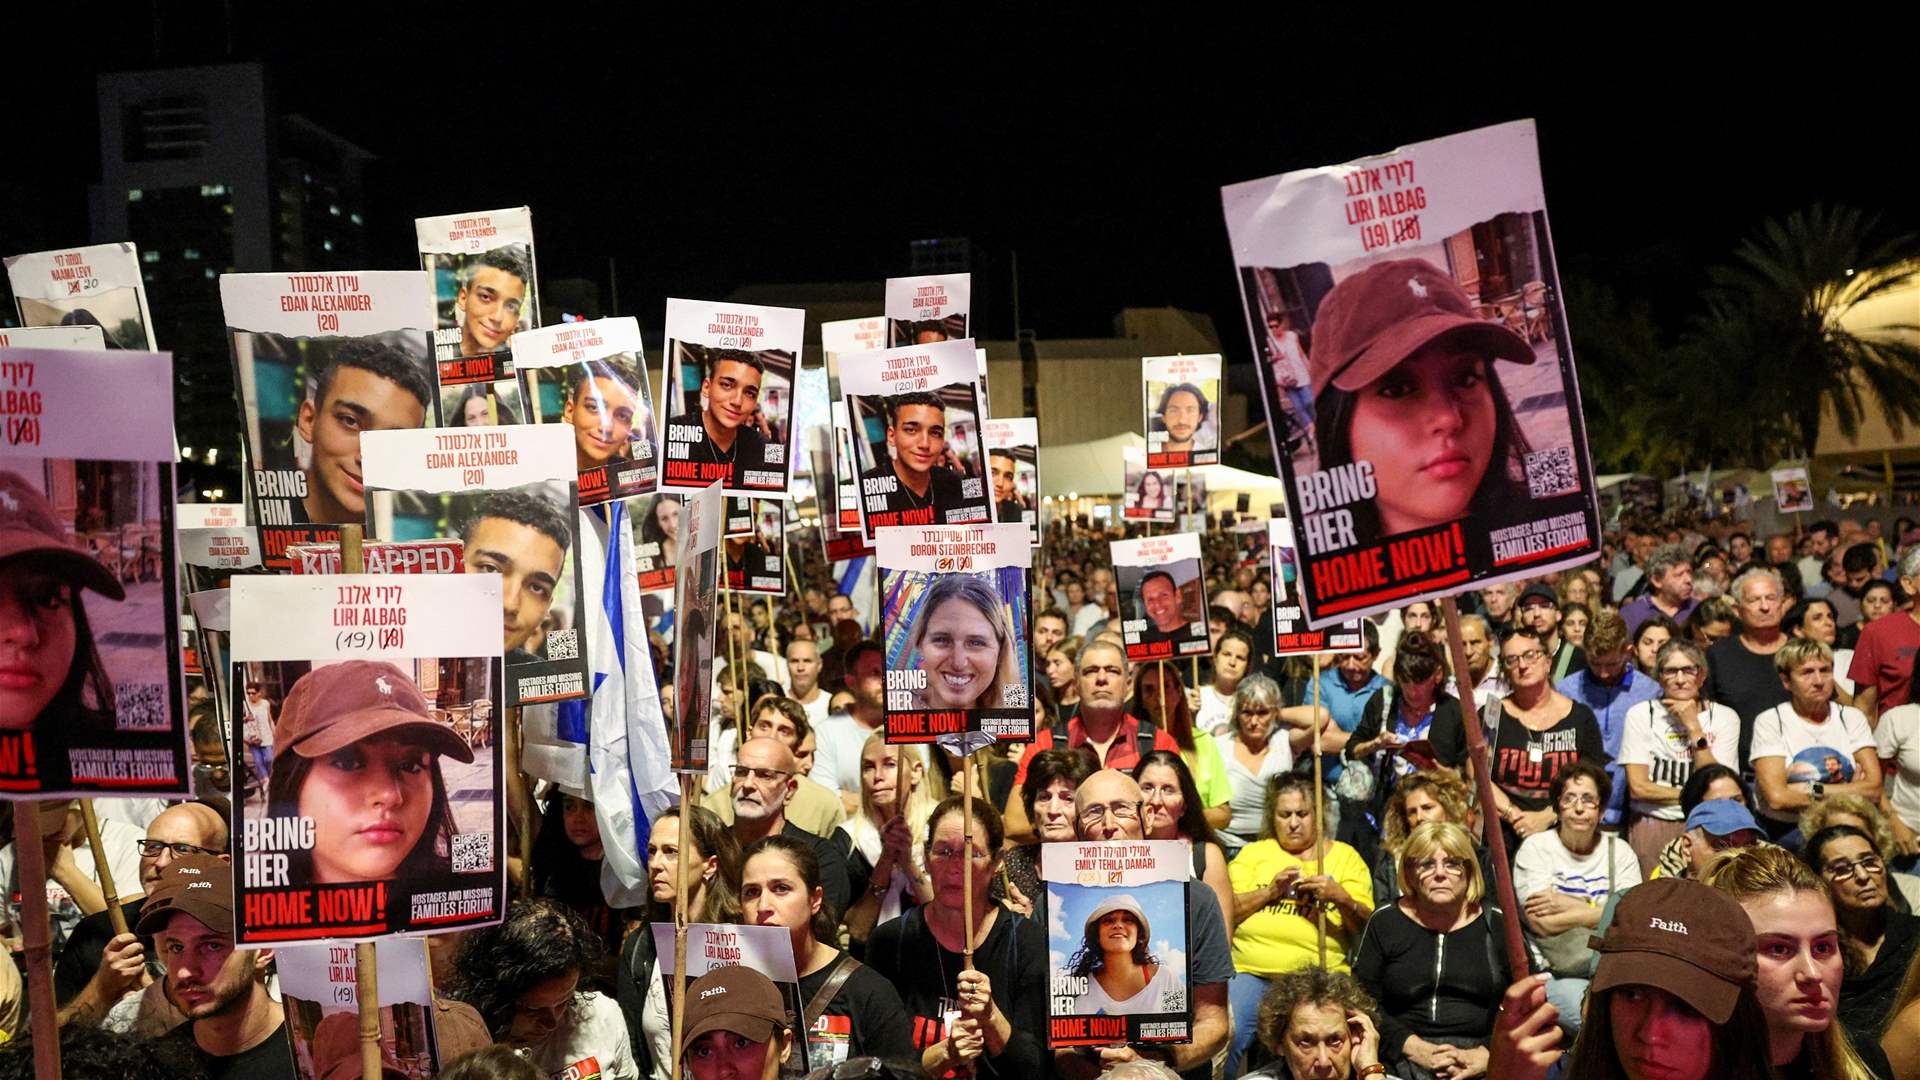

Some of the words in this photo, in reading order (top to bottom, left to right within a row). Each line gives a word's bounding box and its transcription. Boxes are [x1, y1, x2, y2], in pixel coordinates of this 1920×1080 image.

[1343, 167, 1383, 197] אלבג
[1384, 159, 1415, 187] לירי
[1344, 199, 1375, 226] LIRI
[1378, 186, 1427, 218] ALBAG
[449, 230, 464, 241] EDAN
[465, 226, 497, 239] ALEXANDER
[1360, 221, 1390, 252] (19)
[1392, 215, 1421, 243] (18)
[84, 278, 98, 290] 20
[288, 276, 334, 293] אלכסנדר
[337, 276, 359, 293] עידן
[280, 296, 309, 312] EDAN
[311, 294, 372, 312] ALEXANDER
[317, 314, 339, 332] (20)
[708, 323, 725, 335] EDAN
[727, 325, 764, 338] ALEXANDER
[434, 328, 463, 345] BRING
[552, 342, 568, 353] EDAN
[568, 337, 604, 351] ALEXANDER
[719, 336, 738, 347] (20)
[436, 344, 455, 361] HIM
[440, 361, 465, 378] HOME
[465, 356, 494, 376] NOW!
[881, 369, 899, 382] EDAN
[900, 365, 938, 379] ALEXANDER
[894, 379, 914, 392] (20)
[434, 434, 481, 450] אלכסנדר
[485, 433, 507, 450] עידן
[668, 424, 703, 443] BRING
[426, 454, 455, 470] EDAN
[457, 450, 519, 468] ALEXANDER
[667, 442, 690, 460] HIM
[463, 469, 485, 486] (20)
[577, 467, 608, 491] NOW!
[667, 461, 699, 479] HOME
[700, 462, 734, 481] NOW!
[254, 469, 308, 498] BRING
[863, 475, 898, 496] BRING
[1294, 459, 1377, 516] BRING
[258, 499, 293, 526] HIM
[865, 494, 888, 513] HIM
[868, 511, 899, 531] HOME
[901, 505, 935, 526] NOW!
[1302, 508, 1358, 556] HER
[1489, 523, 1533, 543] HOSTAGES
[1532, 518, 1550, 535] AND
[1549, 511, 1586, 531] MISSING
[910, 544, 937, 557] DORON
[938, 542, 996, 556] STEINBRECHER
[1390, 522, 1467, 580] NOW!
[1492, 535, 1547, 562] FAMILIES
[1547, 525, 1589, 549] FORUM
[302, 547, 456, 574] KIDAPPED
[1311, 547, 1389, 600] HOME
[337, 585, 371, 605] אלבג
[376, 585, 403, 605] לירי
[333, 607, 358, 627] LIRI
[362, 607, 407, 627] ALBAG
[336, 631, 375, 651] (19)
[378, 628, 404, 649] (18)
[1278, 633, 1300, 647] HOME
[886, 668, 927, 691] BRING
[519, 683, 555, 700] FAMILIES
[555, 680, 583, 696] FORUM
[887, 691, 913, 711] HER
[888, 713, 926, 734] HOME
[928, 710, 967, 734] NOW!
[1008, 725, 1030, 735] FORUM
[134, 750, 174, 763] MISSING
[71, 763, 128, 779] FAMILIES
[130, 763, 176, 779] FORUM
[243, 815, 317, 852] BRING
[244, 853, 291, 889] HER
[1075, 859, 1097, 872] EMILY
[1099, 858, 1124, 871] TEHILA
[1125, 857, 1156, 870] DAMARI
[1108, 871, 1123, 884] (27)
[318, 882, 387, 924] NOW!
[411, 892, 447, 906] HOSTAGES
[447, 891, 463, 901] AND
[463, 887, 493, 900] MISSING
[244, 889, 313, 928] HOME
[411, 902, 456, 921] FAMILIES
[457, 898, 493, 917] FORUM
[1650, 917, 1689, 935] Faith
[705, 931, 720, 944] אלבג
[721, 932, 737, 947] לירי
[329, 948, 349, 964] אלבג
[704, 945, 717, 958] LIRI
[717, 947, 741, 960] ALBAG
[328, 966, 344, 983] LIRI
[333, 986, 354, 1004] (19)
[700, 986, 727, 1000] Faith
[1051, 975, 1089, 997] BRING
[1050, 995, 1076, 1016] HER
[1051, 1017, 1087, 1038] HOME
[1089, 1013, 1128, 1037] NOW!
